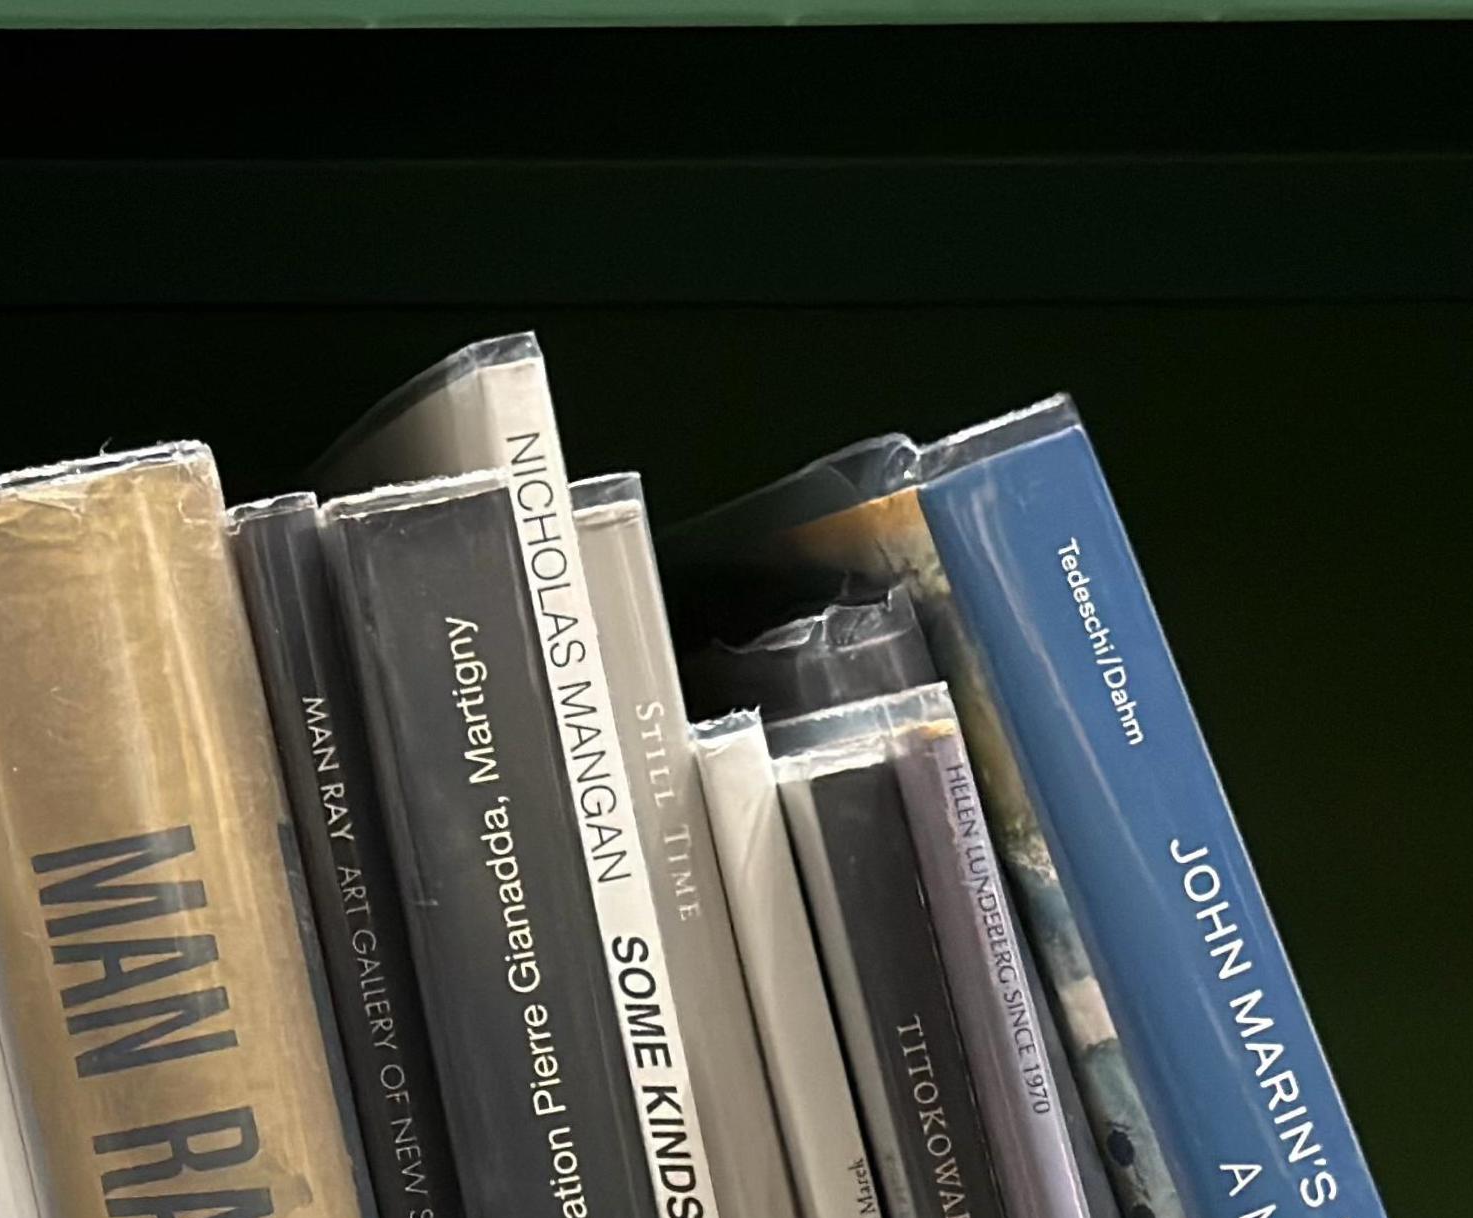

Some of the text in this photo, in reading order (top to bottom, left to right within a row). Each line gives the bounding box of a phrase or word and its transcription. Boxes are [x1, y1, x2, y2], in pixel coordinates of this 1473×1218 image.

[444, 615, 500, 785] Martigny
[1057, 538, 1145, 746] Tedeschi/Dahm
[302, 696, 340, 773] MAN
[507, 431, 585, 668] NICHOLAS
[557, 681, 632, 883] MANGAN
[611, 935, 671, 1070] SOME
[320, 781, 354, 842] RAY
[634, 701, 701, 923] STILL TIME
[30, 822, 240, 1079] MAN
[337, 865, 373, 916] ART
[480, 795, 542, 994] Gianadda,
[946, 763, 980, 838] HELEN
[1002, 989, 1038, 1057] SINCE
[1022, 1062, 1051, 1116] 1970
[352, 929, 399, 1051] GALLERY
[1169, 836, 1253, 980] JOHN
[1229, 989, 1338, 1210] MARIN'S
[380, 1063, 410, 1106] OF
[523, 1003, 566, 1117] Pierre
[390, 1117, 429, 1196] NEW
[847, 1157, 876, 1214] Marek
[1220, 1160, 1261, 1199] A
